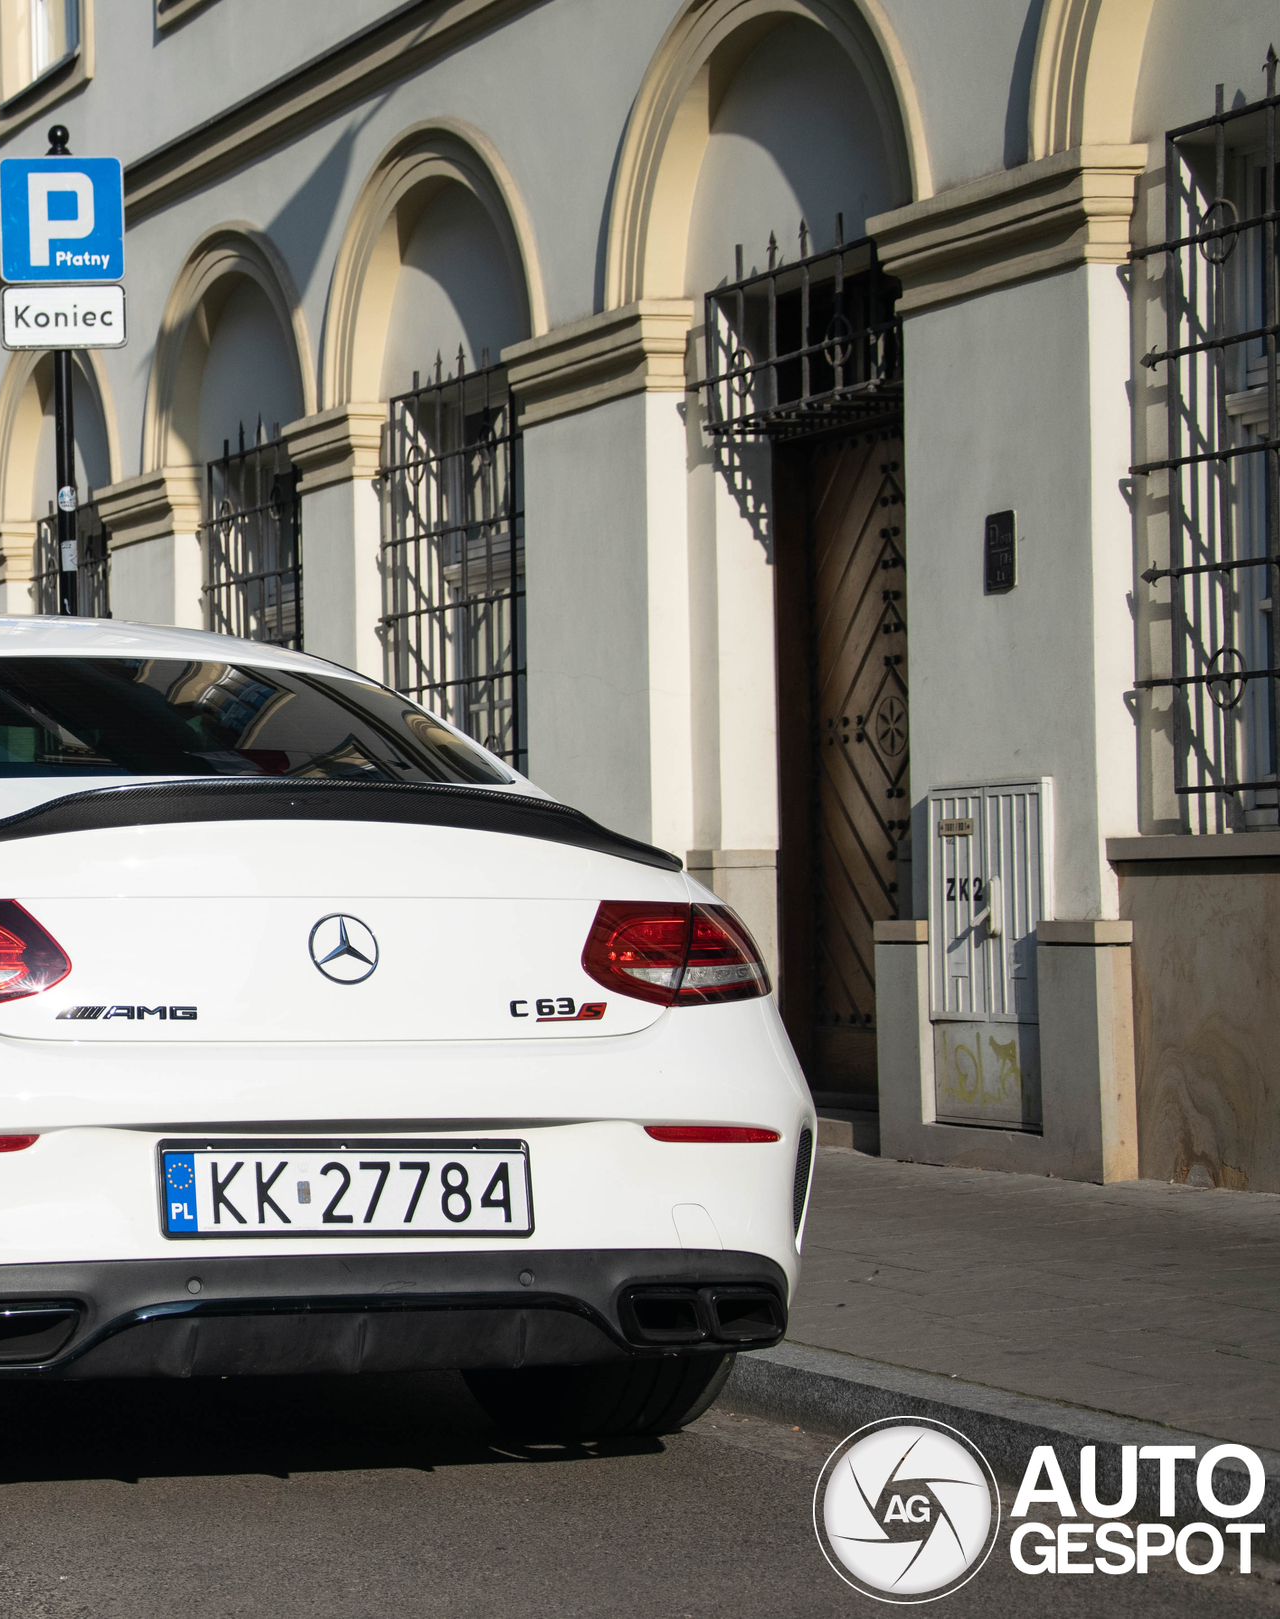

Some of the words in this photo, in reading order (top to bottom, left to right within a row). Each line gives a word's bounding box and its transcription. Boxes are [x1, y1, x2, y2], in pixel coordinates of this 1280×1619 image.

[27, 171, 95, 266] P
[55, 250, 110, 270] Płatny
[14, 304, 113, 328] Koniec
[102, 1005, 197, 1020] AMG
[509, 1000, 529, 1017] C
[210, 1161, 292, 1224] KK
[320, 1161, 512, 1224] 27784
[171, 1202, 194, 1220] PL
